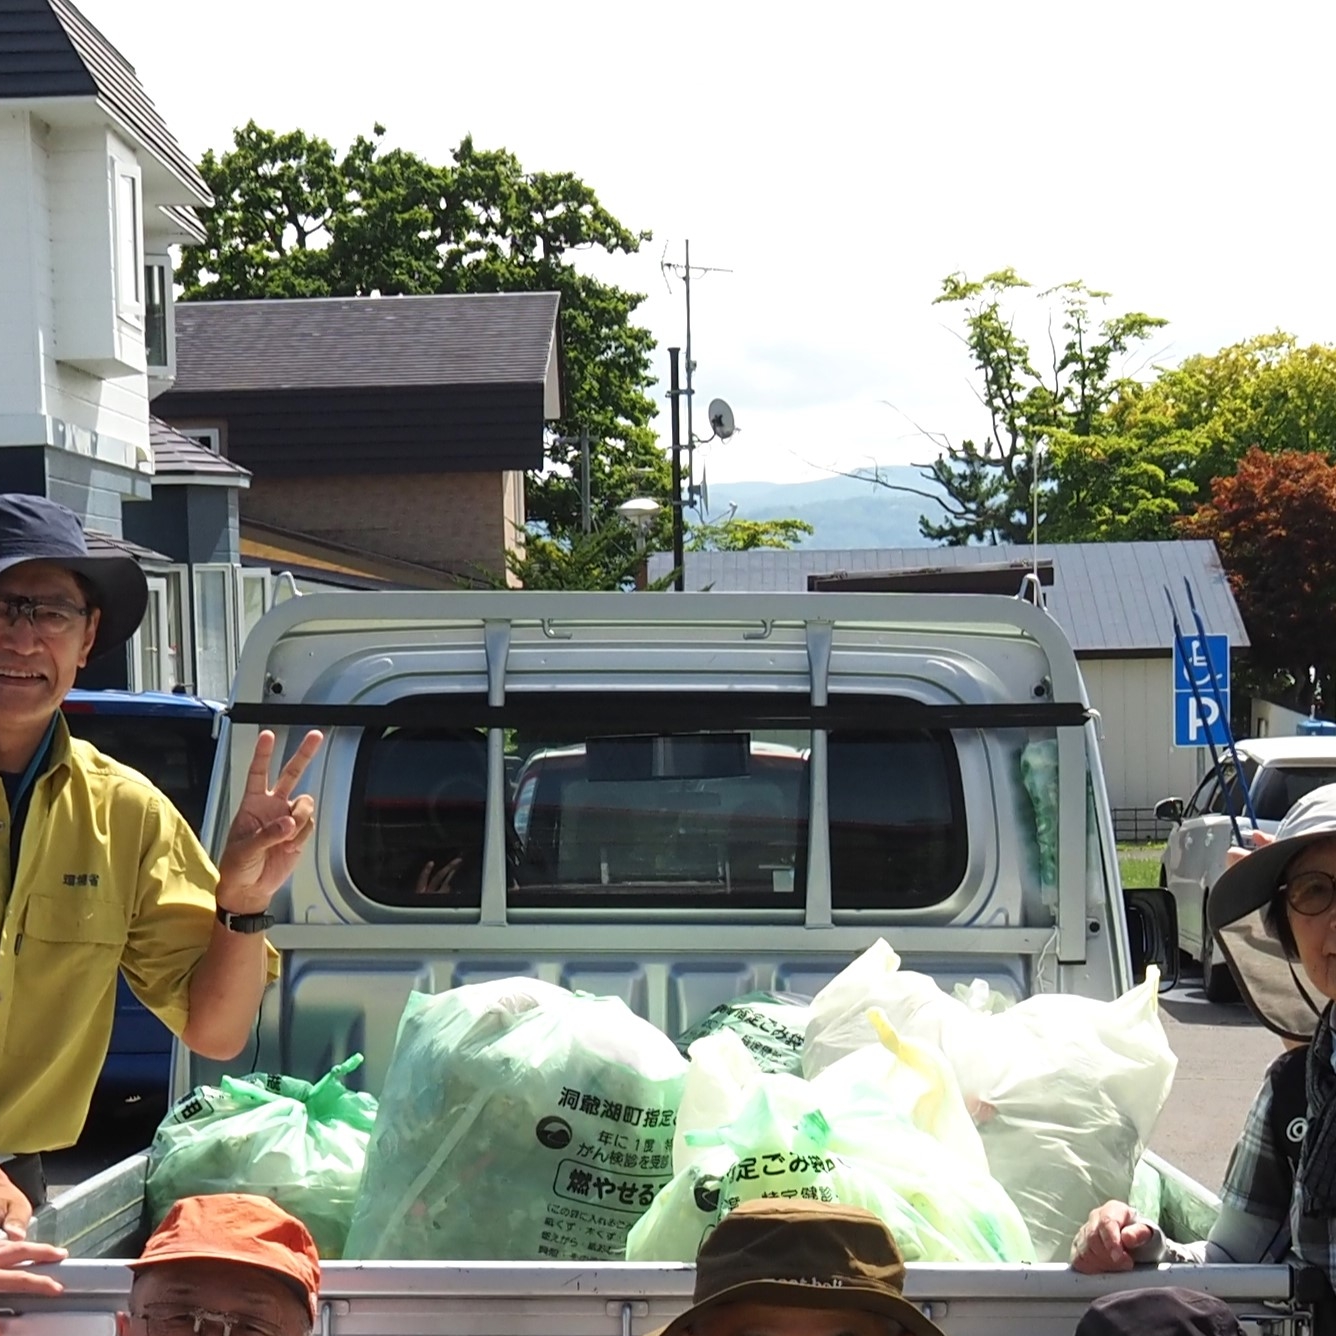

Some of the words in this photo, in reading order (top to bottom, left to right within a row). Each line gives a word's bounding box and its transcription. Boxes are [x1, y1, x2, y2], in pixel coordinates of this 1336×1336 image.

[1188, 696, 1220, 742] P
[557, 1085, 677, 1129] 洞爺湖町指定
[566, 1167, 666, 1206] 燃やせる
